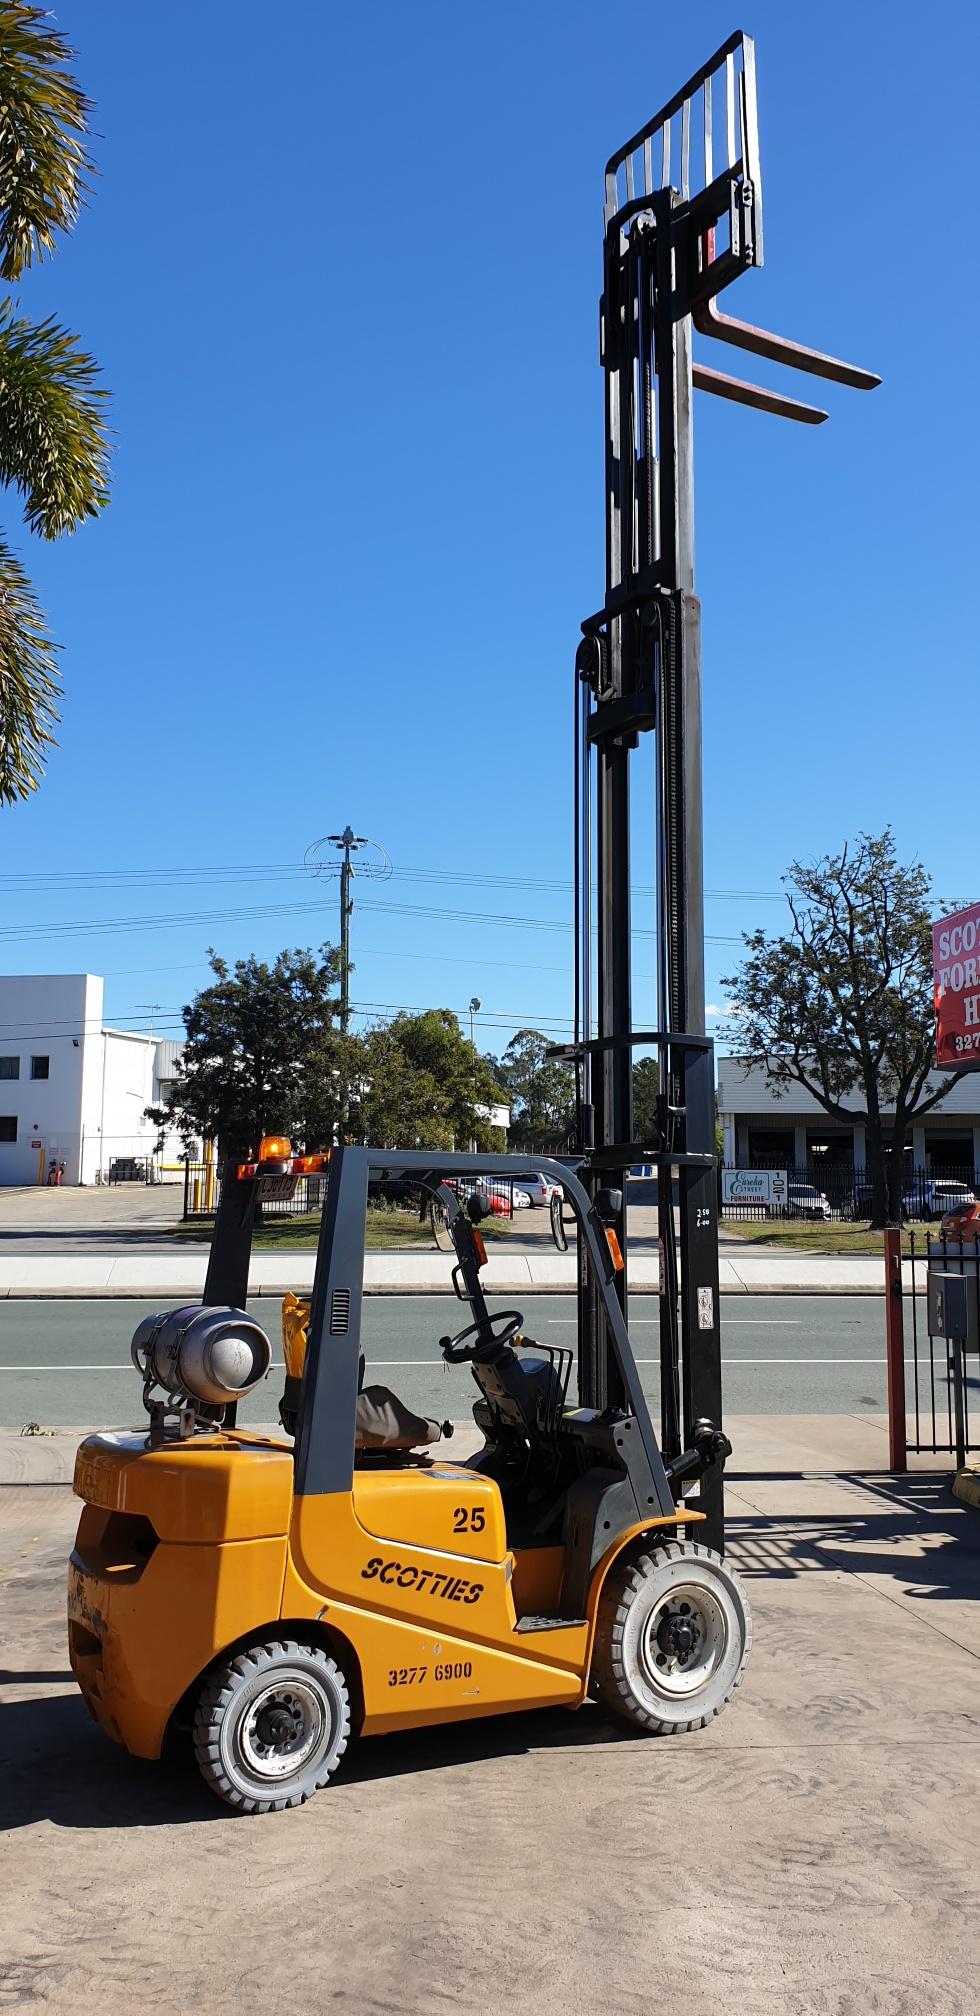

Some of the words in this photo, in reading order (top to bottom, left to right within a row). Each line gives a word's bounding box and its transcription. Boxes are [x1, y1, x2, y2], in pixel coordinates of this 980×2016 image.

[939, 956, 980, 996] FOR
[964, 994, 980, 1027] H
[453, 1507, 486, 1533] 25
[361, 1558, 484, 1604] SCOTTIES
[388, 1666, 428, 1687] 3277
[434, 1662, 472, 1681] 6900
